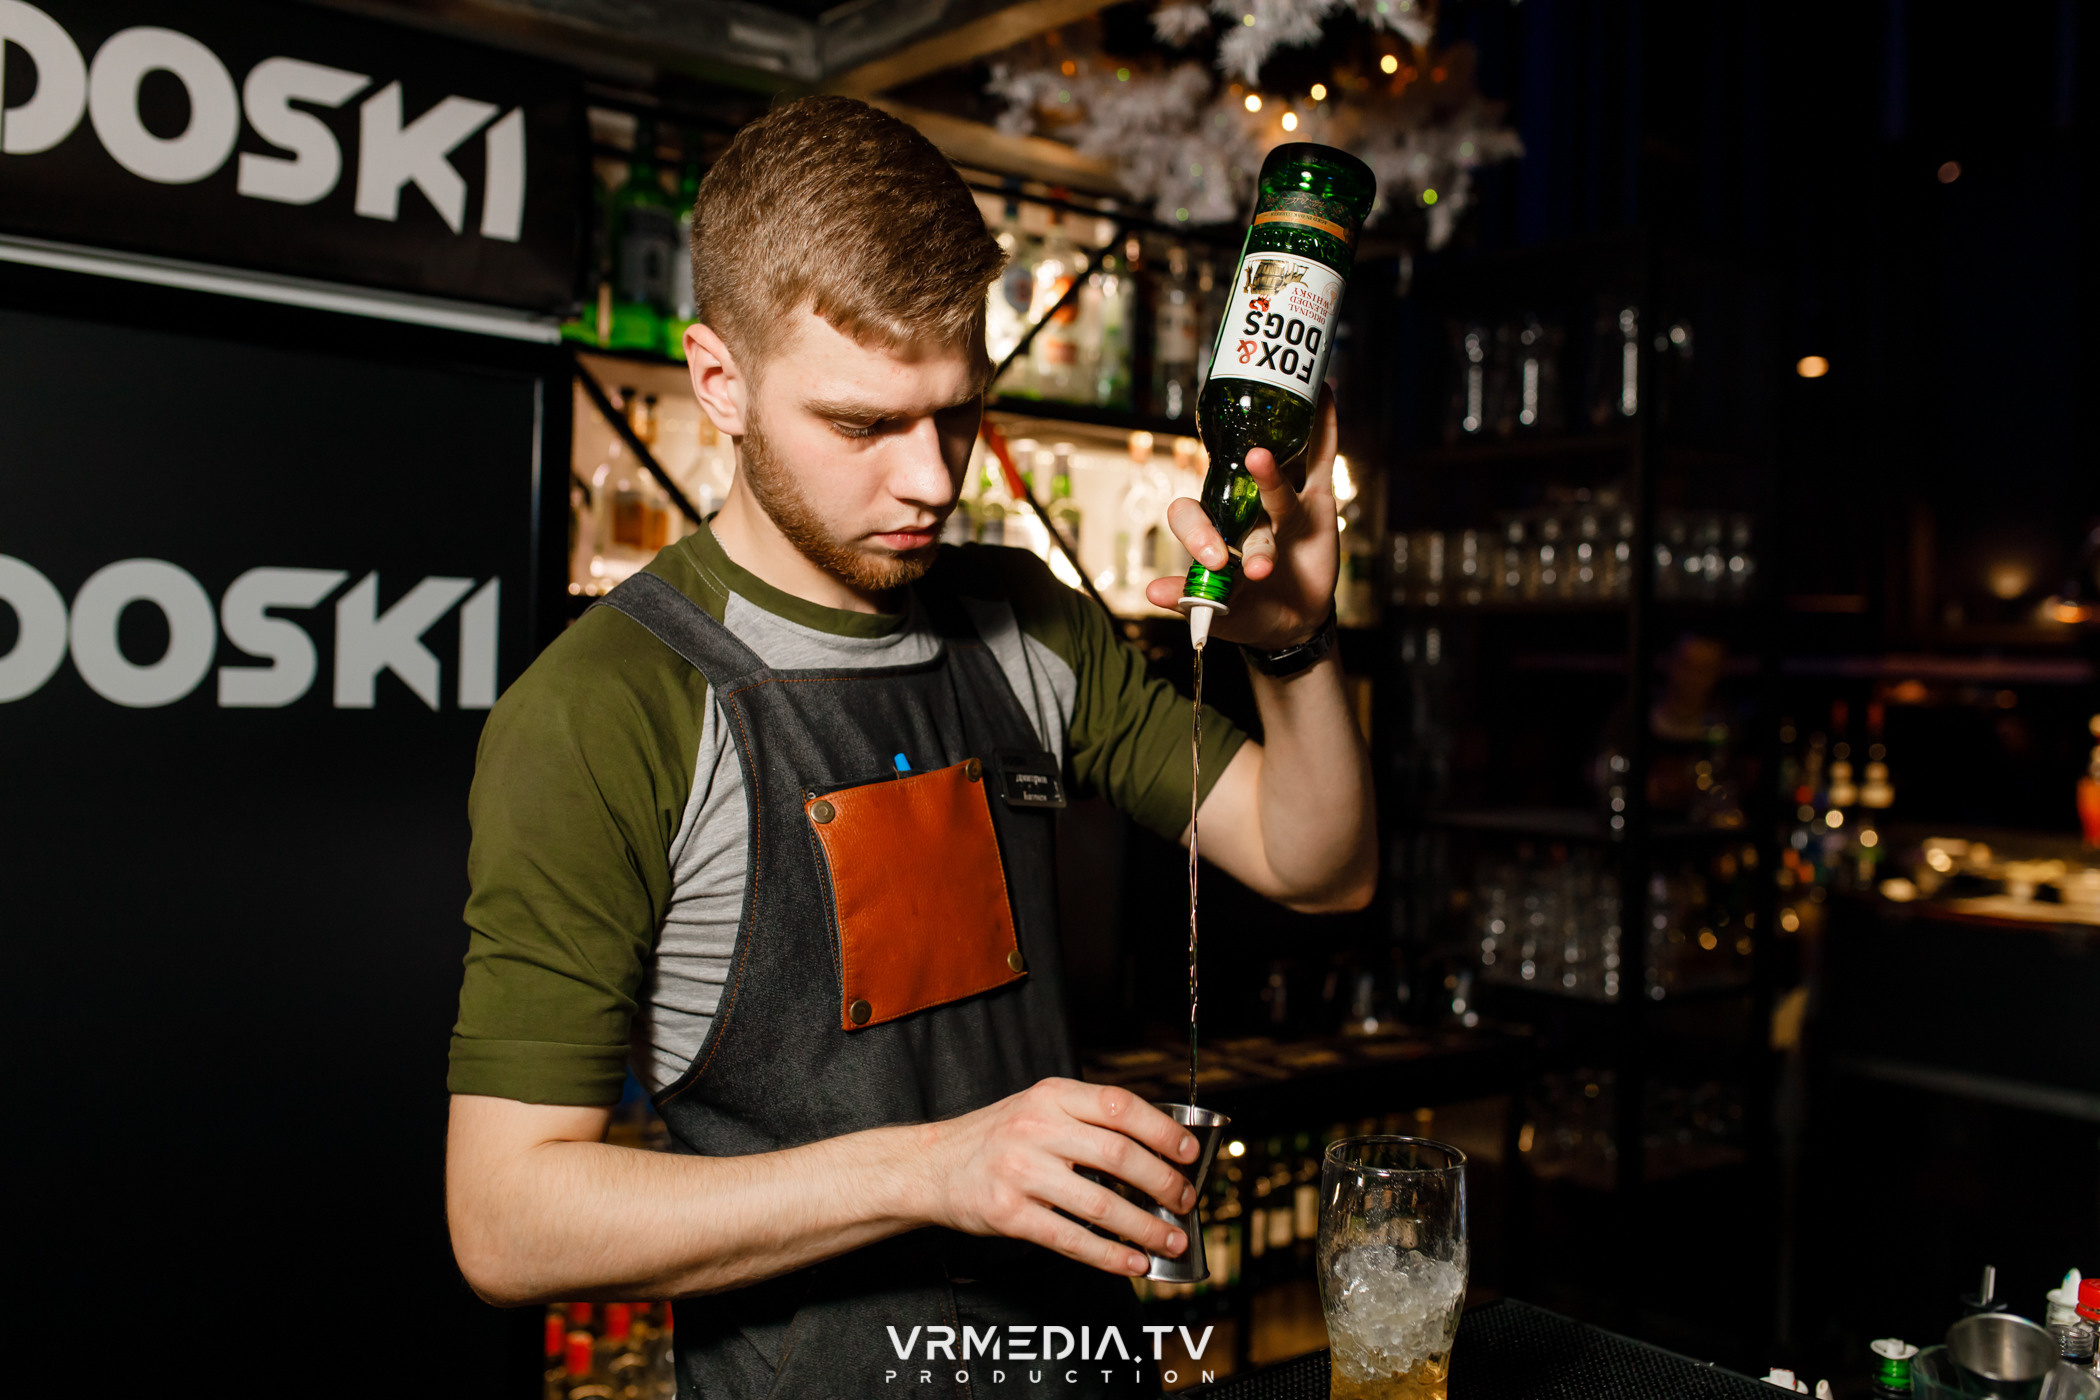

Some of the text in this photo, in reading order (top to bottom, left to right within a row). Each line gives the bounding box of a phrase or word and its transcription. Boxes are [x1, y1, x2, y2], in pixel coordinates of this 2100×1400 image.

[1290, 296, 1328, 317] BLENDED
[1293, 288, 1329, 309] WHISKY
[1289, 303, 1326, 325] ORIGINAL
[1243, 310, 1322, 355] DOGS
[1237, 339, 1314, 384] FOX &
